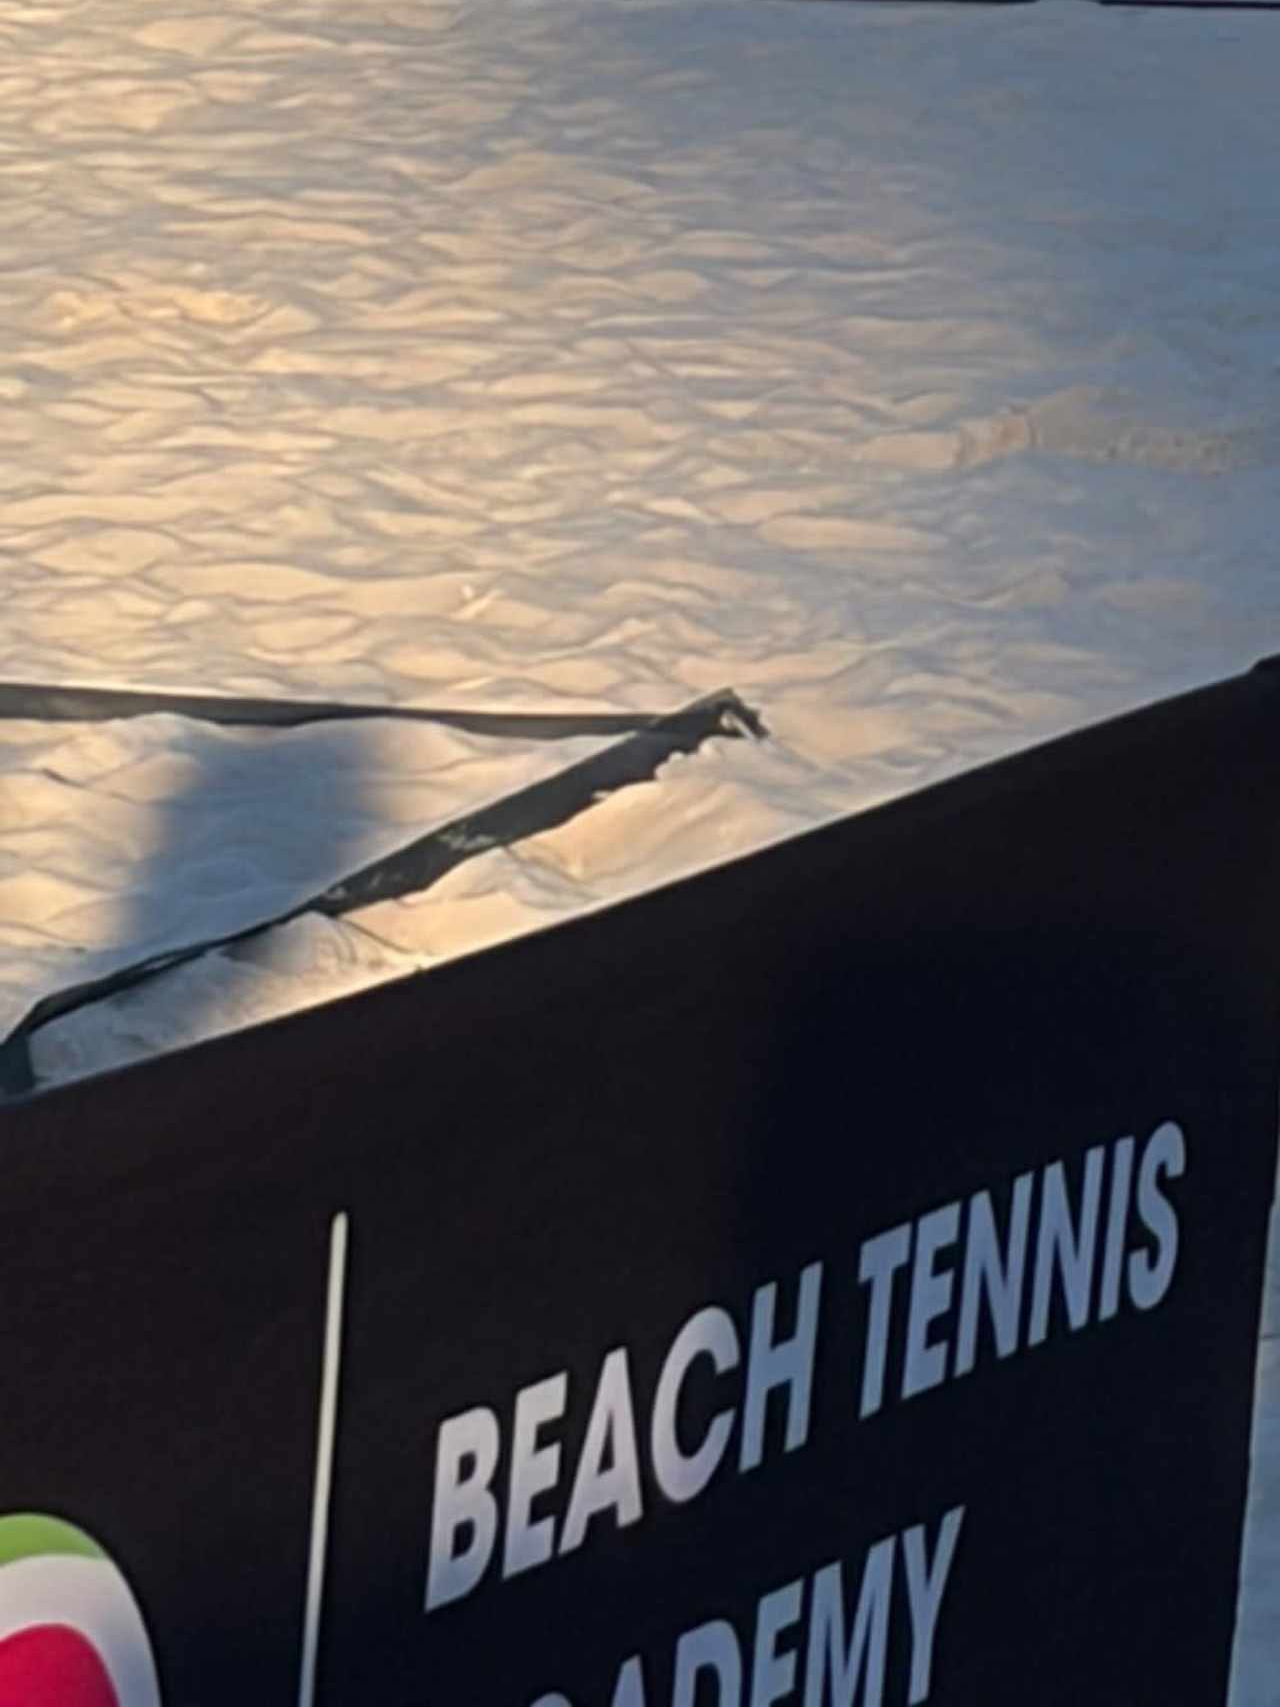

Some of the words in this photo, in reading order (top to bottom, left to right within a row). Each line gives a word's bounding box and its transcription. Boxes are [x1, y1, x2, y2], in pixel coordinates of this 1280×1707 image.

[425, 1260, 823, 1613] BEACH
[858, 1121, 1187, 1421] TENNIS
[525, 1503, 966, 1707] DEMY
